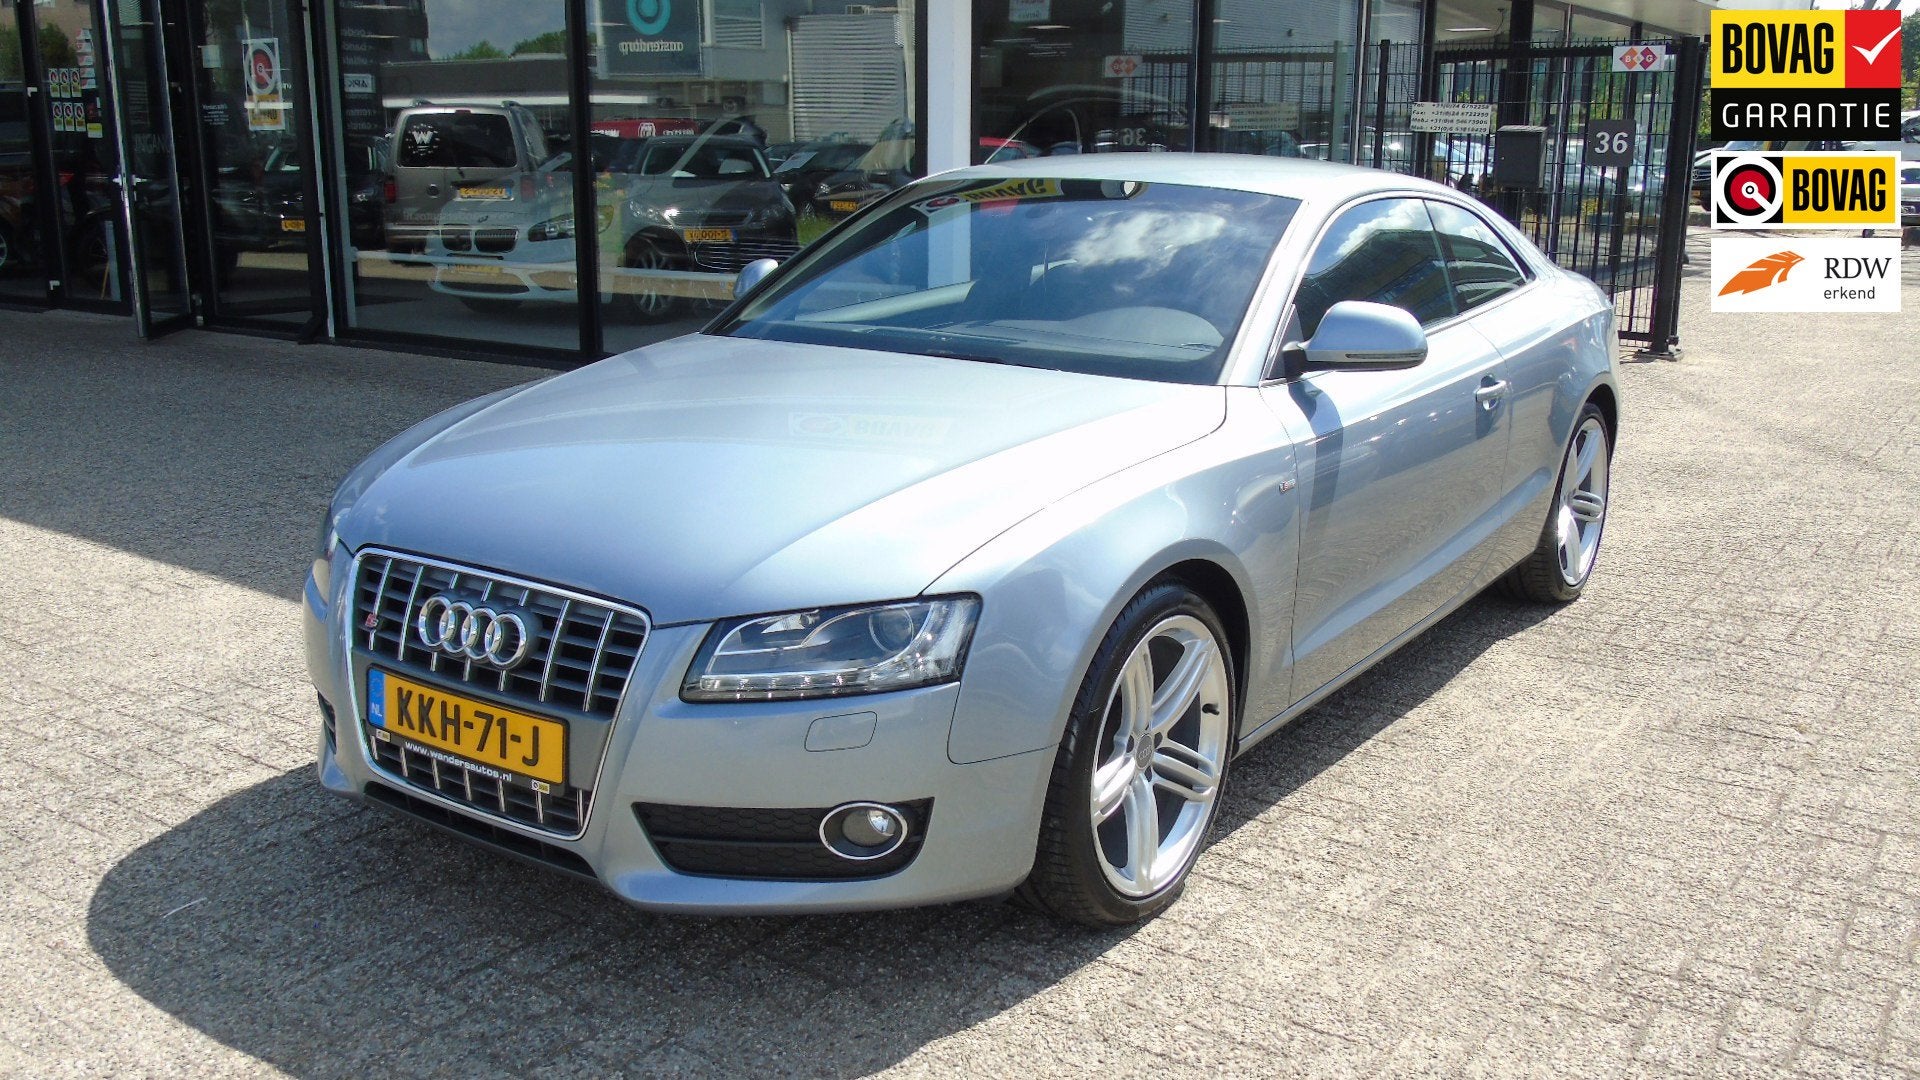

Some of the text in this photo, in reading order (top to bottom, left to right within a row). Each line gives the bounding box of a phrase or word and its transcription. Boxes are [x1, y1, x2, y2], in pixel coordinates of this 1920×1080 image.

[1595, 132, 1628, 154] 36
[371, 702, 383, 717] NL
[397, 686, 539, 766] KKH-71-J
[405, 741, 512, 782] www.wandersautos.nl
